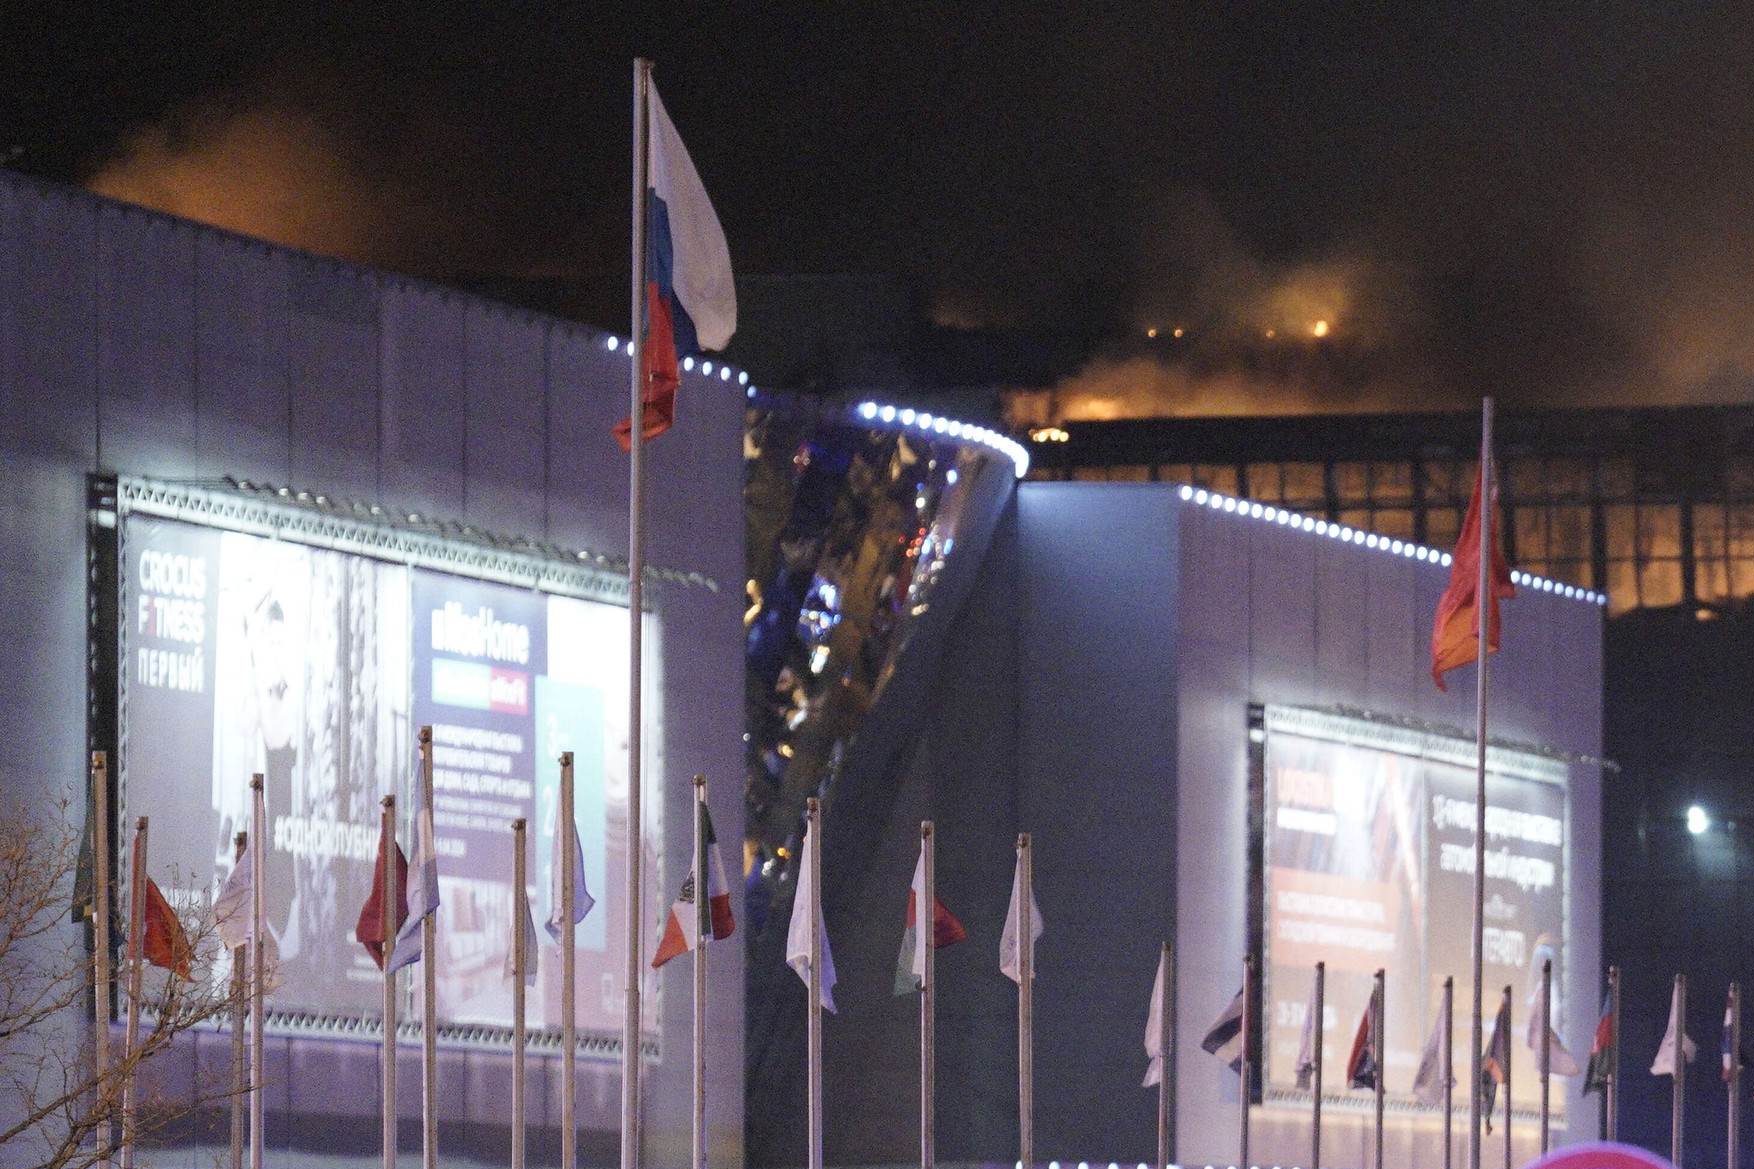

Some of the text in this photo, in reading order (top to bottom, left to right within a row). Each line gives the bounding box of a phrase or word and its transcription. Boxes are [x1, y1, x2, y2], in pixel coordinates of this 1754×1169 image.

[139, 549, 206, 600] CROCUS
[138, 594, 205, 644] FITNESS
[138, 646, 204, 693] ПЕРВЫЙ
